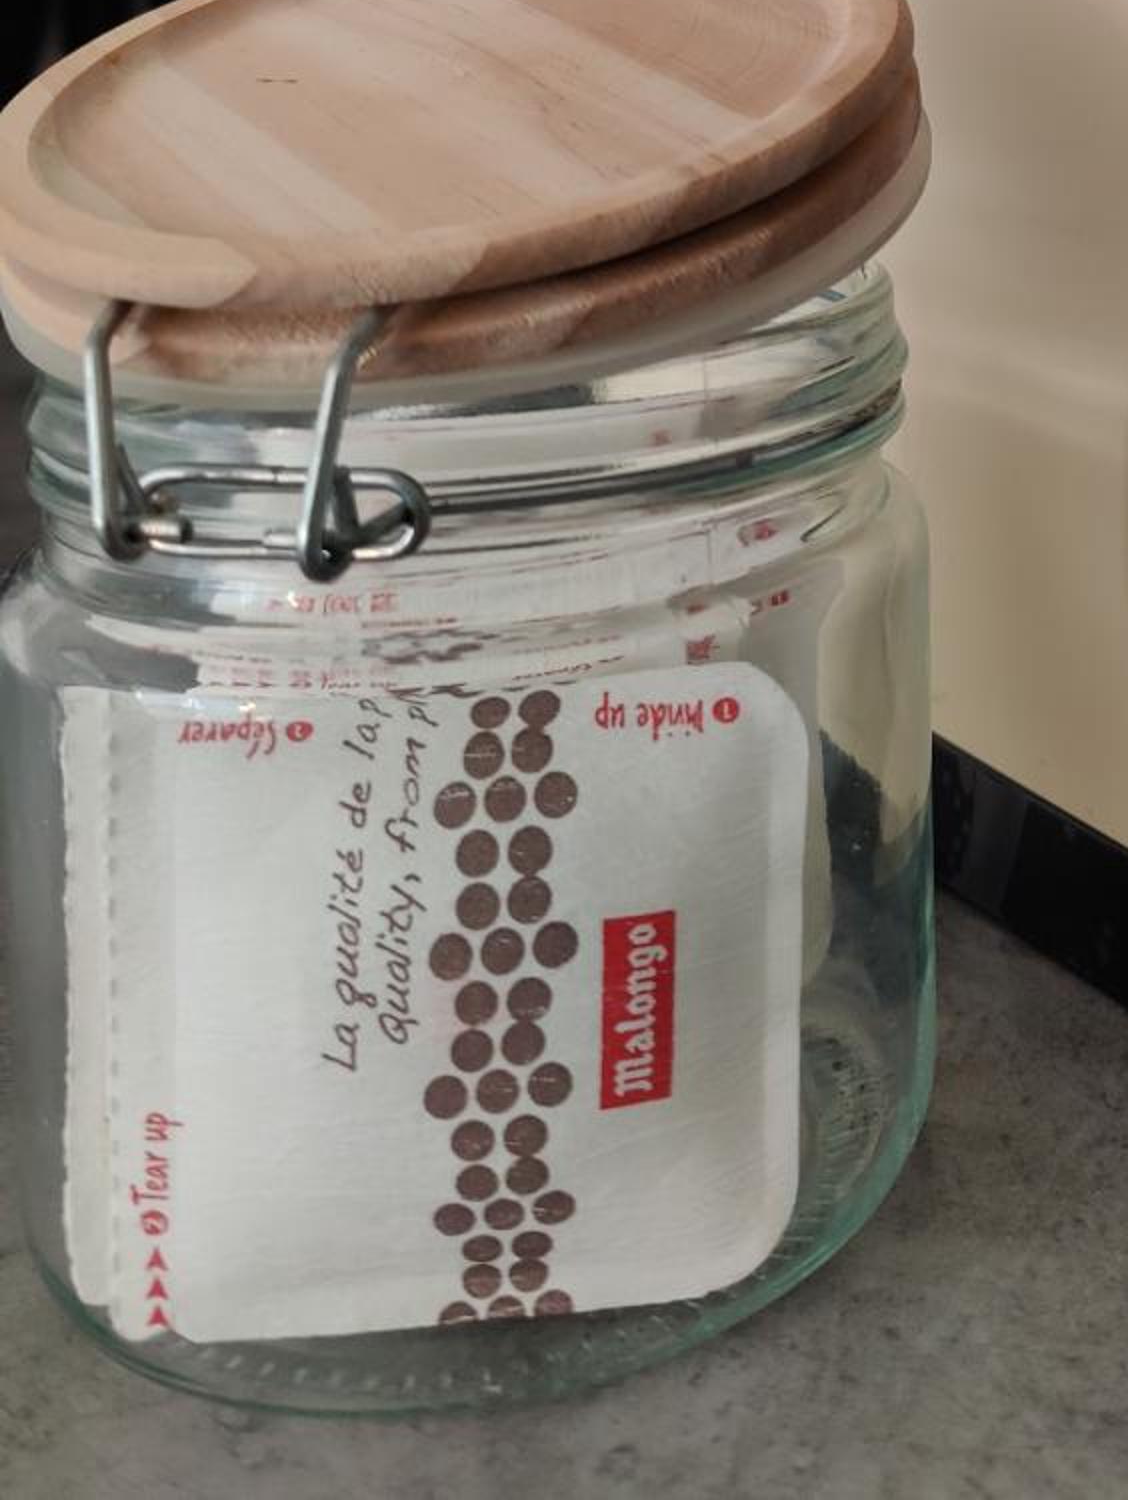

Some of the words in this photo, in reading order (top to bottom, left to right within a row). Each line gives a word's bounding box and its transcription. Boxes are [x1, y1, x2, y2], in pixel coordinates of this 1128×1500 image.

[594, 691, 625, 731] up
[176, 712, 277, 761] Séparer
[338, 781, 371, 828] de
[384, 737, 426, 854] from
[327, 848, 377, 1006] qualité
[613, 922, 668, 1097] Malongo
[321, 1023, 360, 1072] La
[143, 1112, 184, 1141] up
[130, 1150, 169, 1205] Tear
